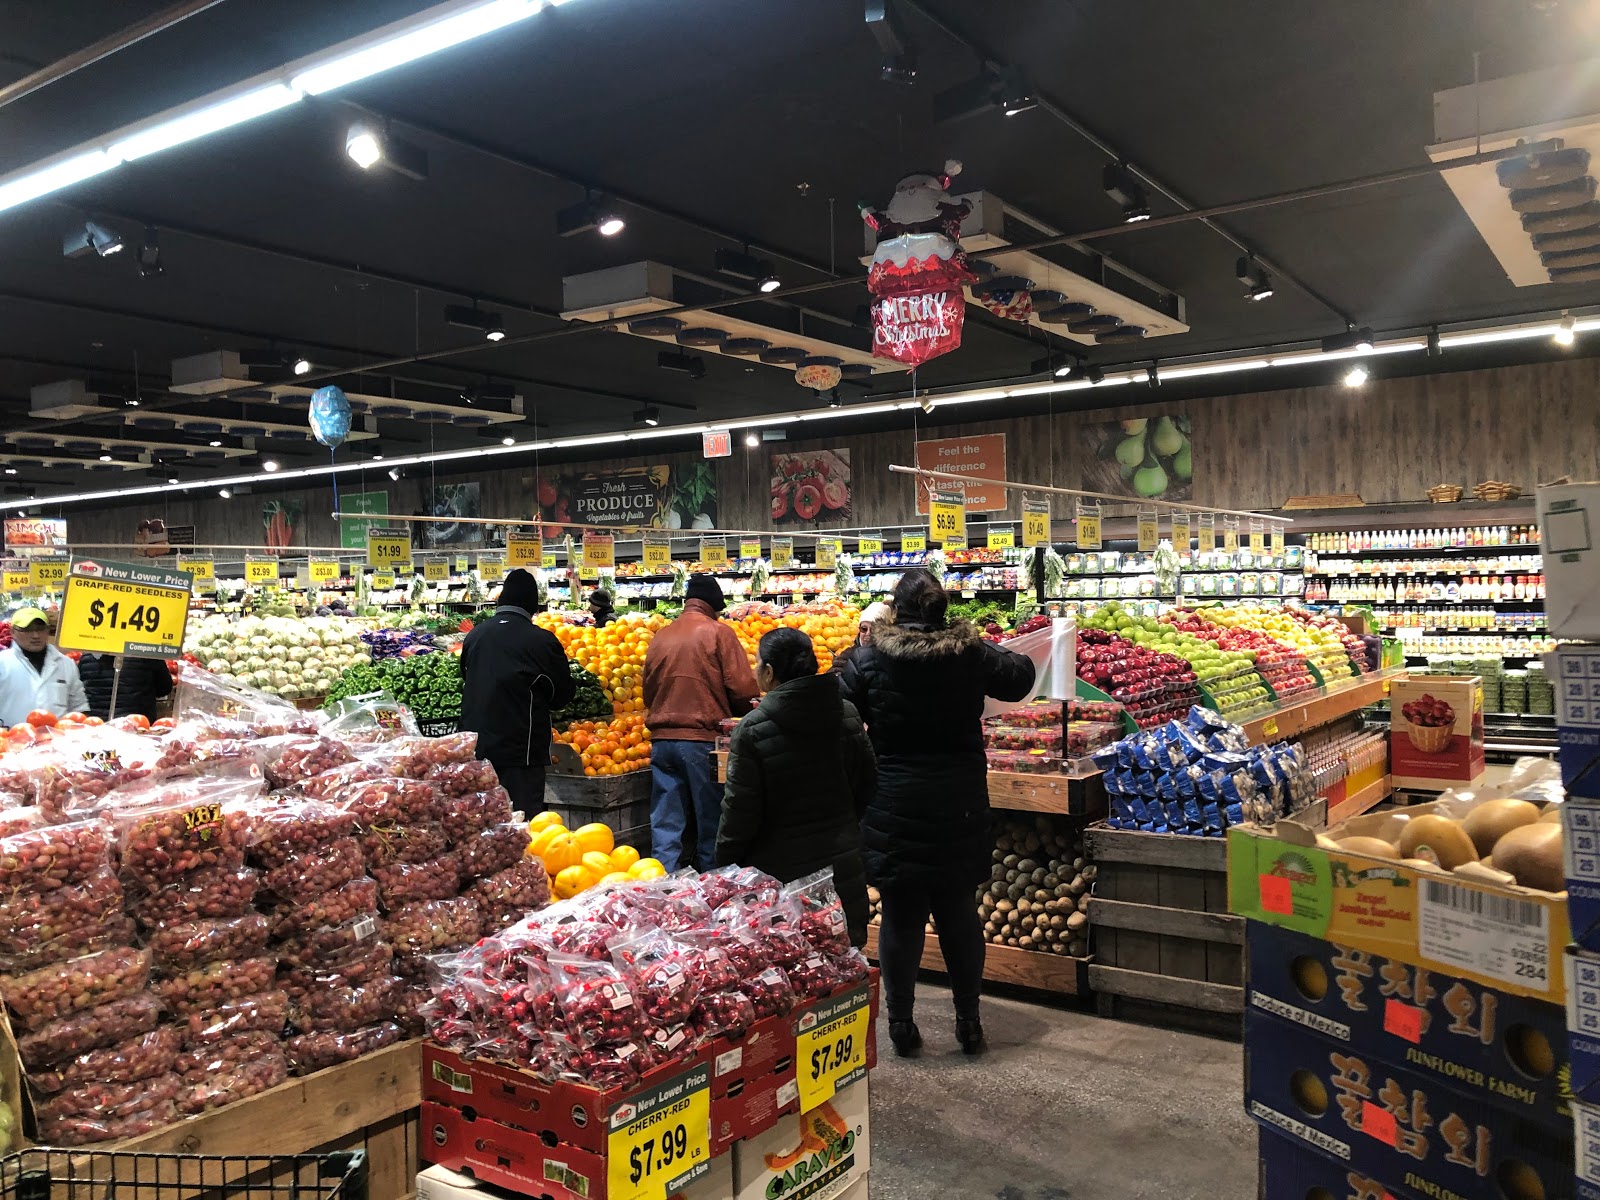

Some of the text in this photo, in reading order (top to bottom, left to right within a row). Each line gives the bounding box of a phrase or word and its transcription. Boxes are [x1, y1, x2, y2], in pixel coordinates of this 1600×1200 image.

[881, 293, 947, 325] MERRY
[875, 320, 951, 345] Christmas
[707, 435, 728, 456] EXIT
[938, 445, 980, 456] Feel the
[934, 462, 986, 473] difference
[602, 482, 627, 494] Fresh
[937, 480, 963, 490] taste
[576, 493, 654, 512] PRODUCE
[586, 512, 620, 524] Vegetables
[626, 511, 645, 522] fruits
[6, 523, 57, 534] KIMCHI
[1028, 521, 1044, 536] $1.49
[377, 544, 401, 558] $1.99
[993, 537, 1008, 545] $2.49
[10, 576, 29, 584] $4.49
[39, 569, 63, 579] $2.99
[105, 566, 190, 587] New Lower Price
[252, 567, 271, 577] $2.99
[75, 579, 184, 600] GRAPE-RED SEEDLESS
[88, 598, 160, 633] $1.49
[129, 643, 157, 654] Compare
[164, 646, 178, 655] Save
[1515, 961, 1546, 981] 284
[817, 992, 868, 1021] New Lower Price
[1252, 990, 1349, 1039] Produce of Mexico
[812, 1013, 857, 1041] CHERRY-RED
[811, 1034, 853, 1083] $7.99
[852, 1055, 860, 1064] LB
[855, 1067, 865, 1077] Save
[1406, 1047, 1537, 1105] SUNFLOWER FARMS
[637, 1073, 707, 1113] New Lower Price
[628, 1098, 691, 1136] CHERRY-RED
[1252, 1101, 1349, 1158] Produce of Mexico
[629, 1123, 688, 1188] $7.99
[691, 1147, 701, 1159] LB
[765, 1129, 856, 1200] CARAVEO
[668, 1163, 709, 1191] Compare & Save
[787, 1165, 841, 1200] APAYAS
